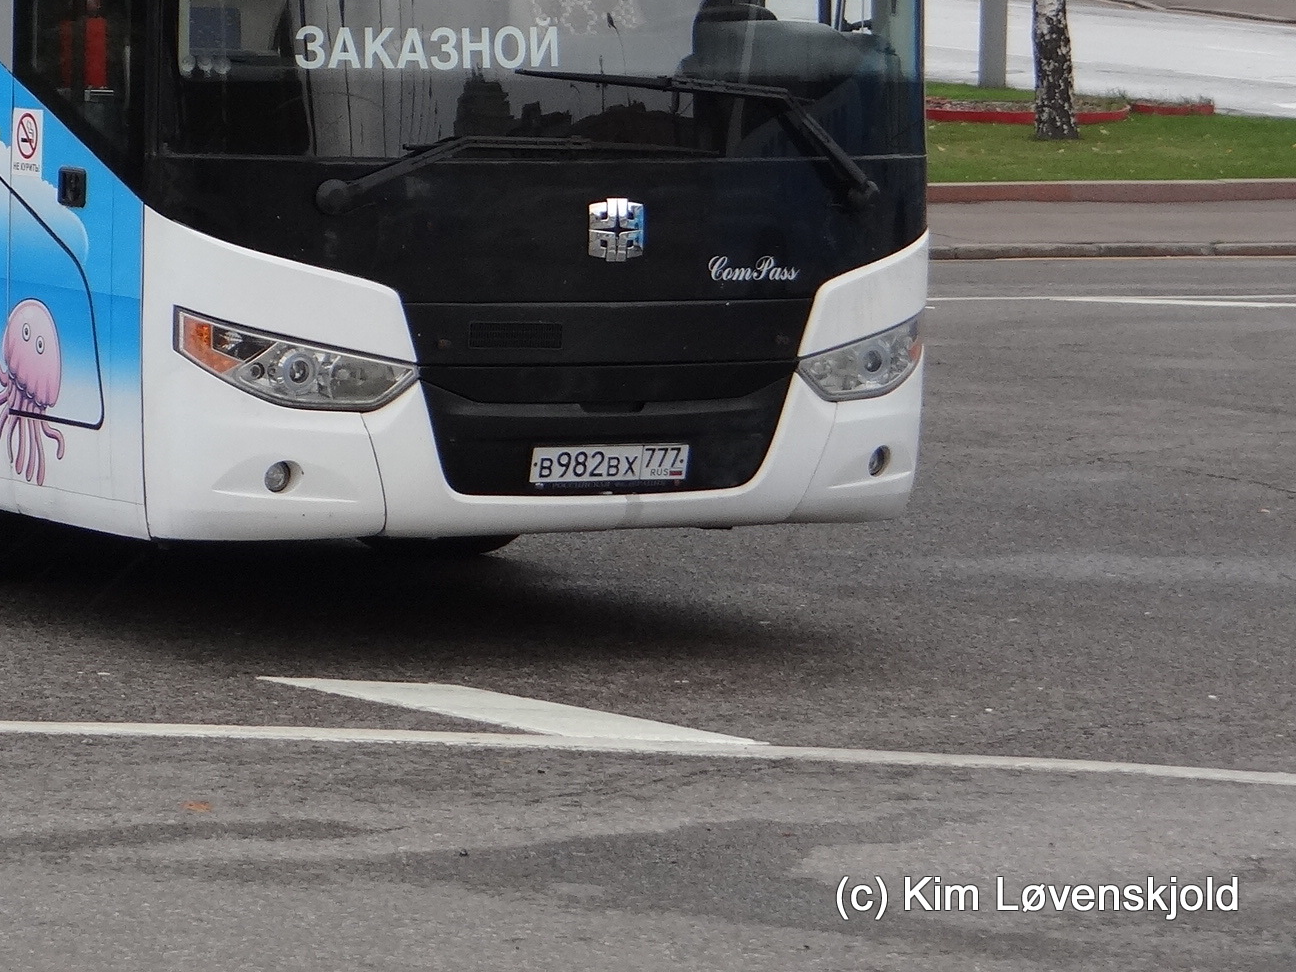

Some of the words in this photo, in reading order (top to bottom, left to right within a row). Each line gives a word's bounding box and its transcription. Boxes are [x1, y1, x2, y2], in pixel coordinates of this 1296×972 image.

[294, 16, 560, 70] ЗАКАЗНОЙ
[708, 255, 800, 281] ComPass
[644, 447, 681, 468] 777
[649, 468, 669, 477] RUS
